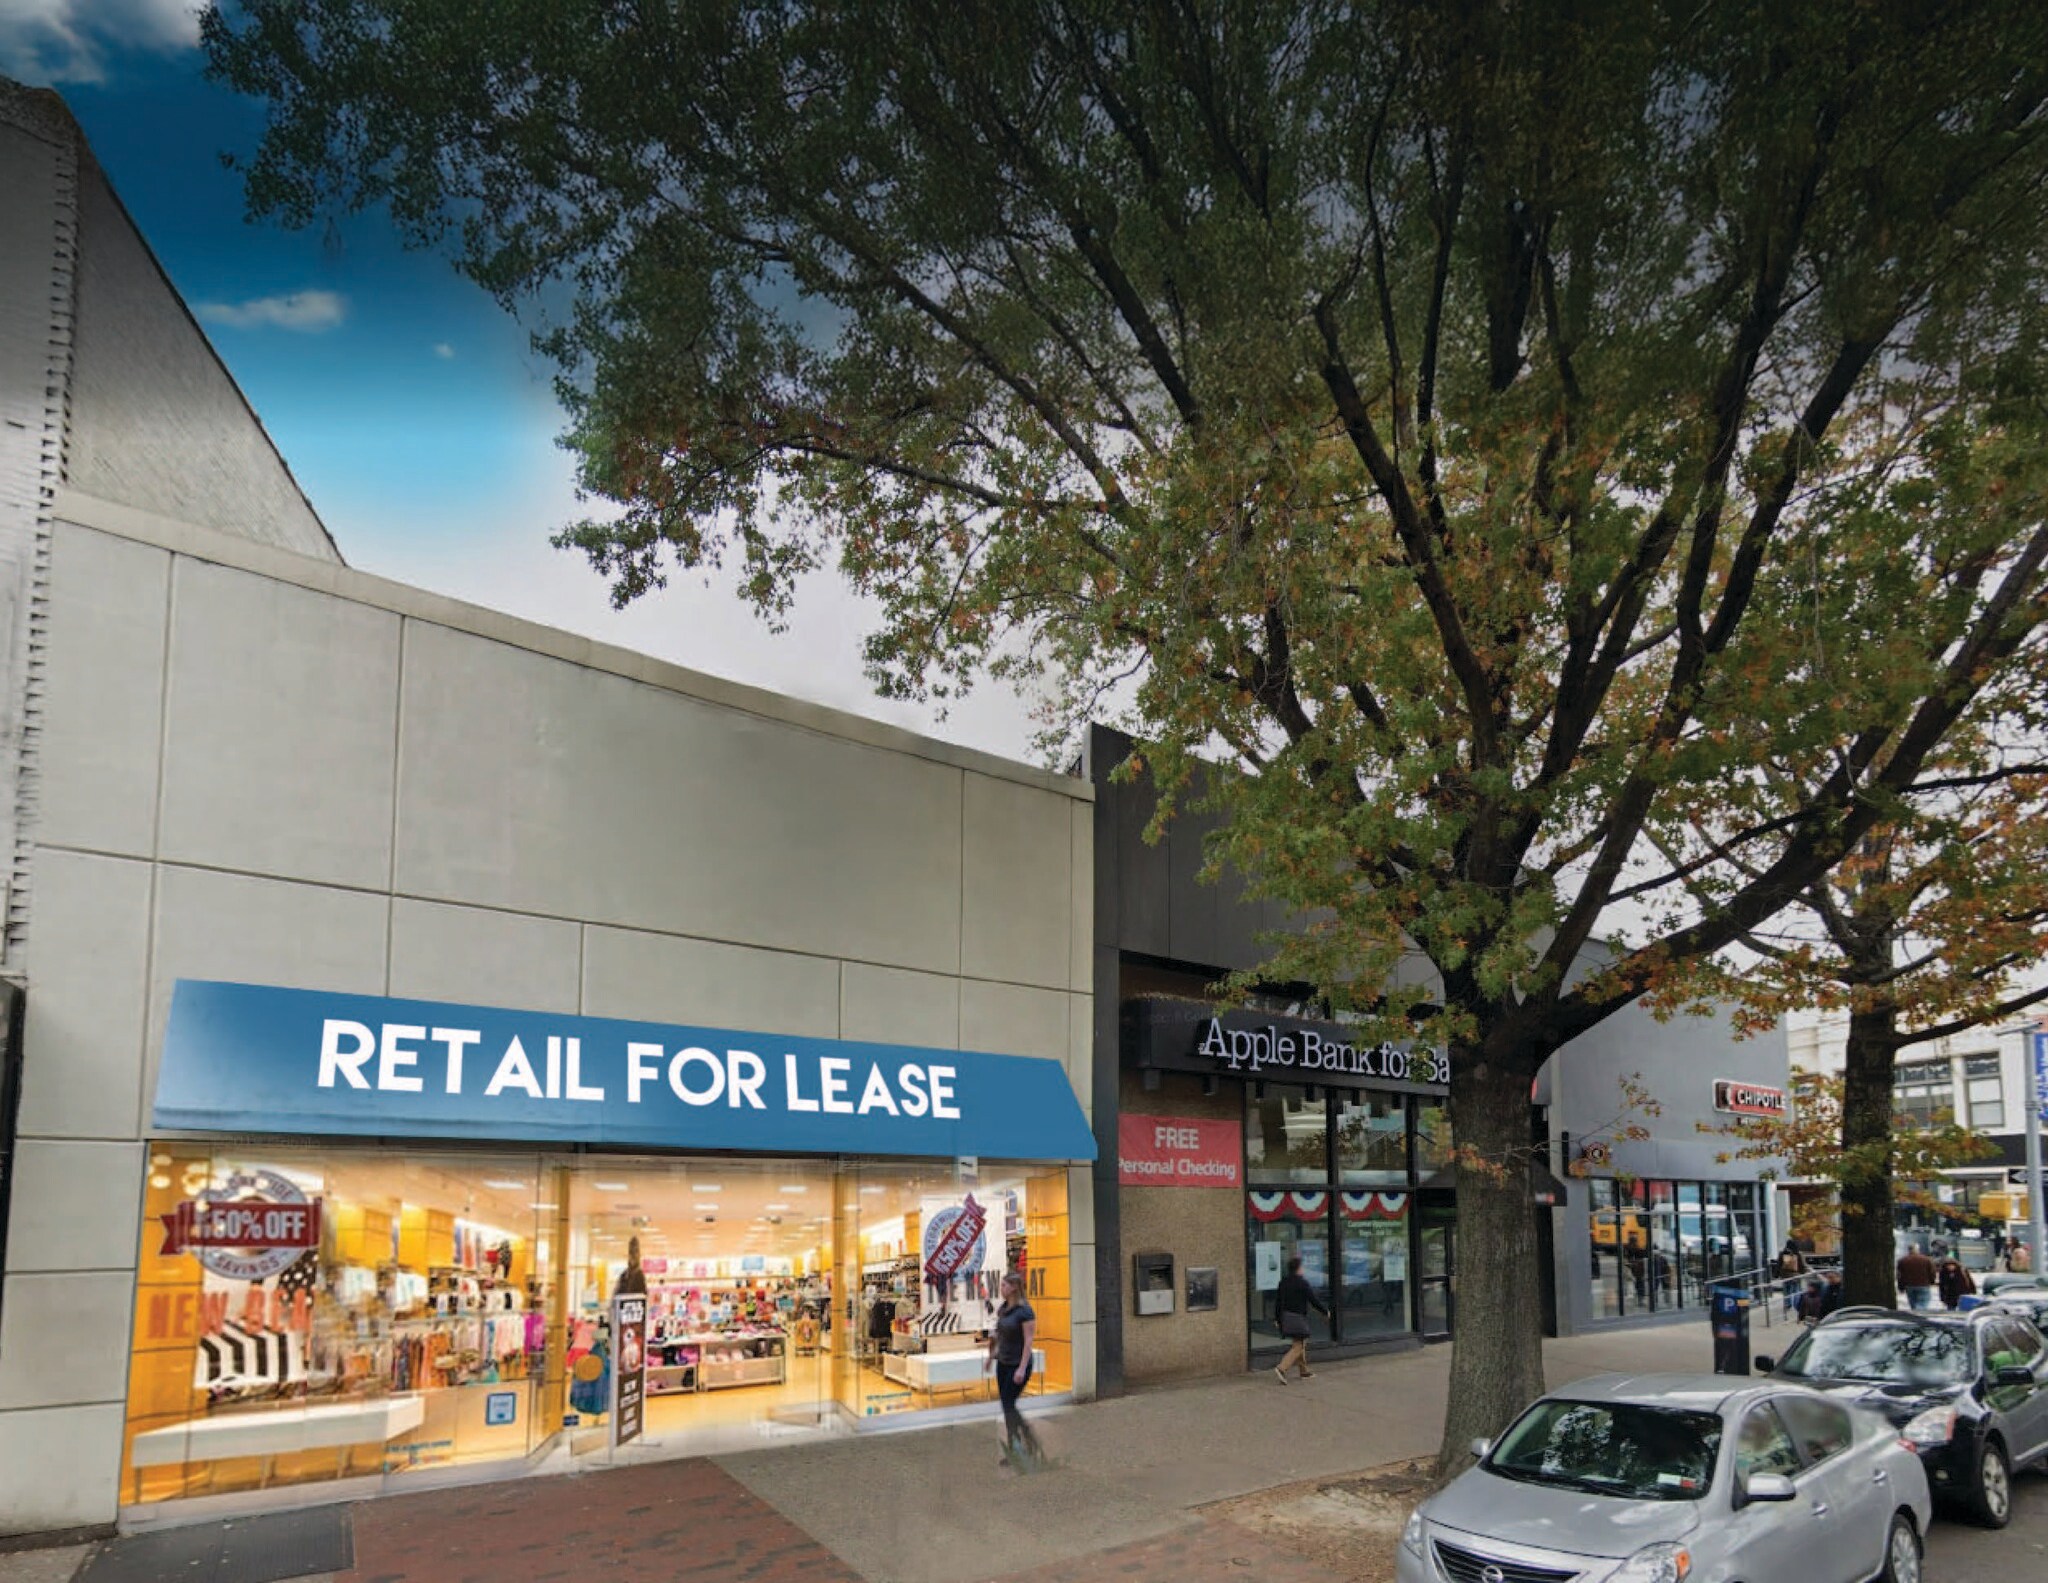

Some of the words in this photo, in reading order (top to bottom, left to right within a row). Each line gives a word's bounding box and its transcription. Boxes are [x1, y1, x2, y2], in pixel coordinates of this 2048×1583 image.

[1199, 1017, 1296, 1072] Apple
[1300, 1030, 1376, 1076] Bank
[317, 1019, 605, 1101] RETAIL
[627, 1042, 767, 1109] FOR
[785, 1054, 961, 1119] LEASE
[1737, 1089, 1787, 1110] CHIPOTLE
[1155, 1126, 1200, 1149] FREE
[1178, 1158, 1236, 1180] Checking
[211, 1208, 262, 1240] 50%
[265, 1210, 306, 1240] OFF
[955, 1214, 978, 1244] OFF
[148, 1291, 229, 1341] NEW
[1723, 1297, 1736, 1312] P
